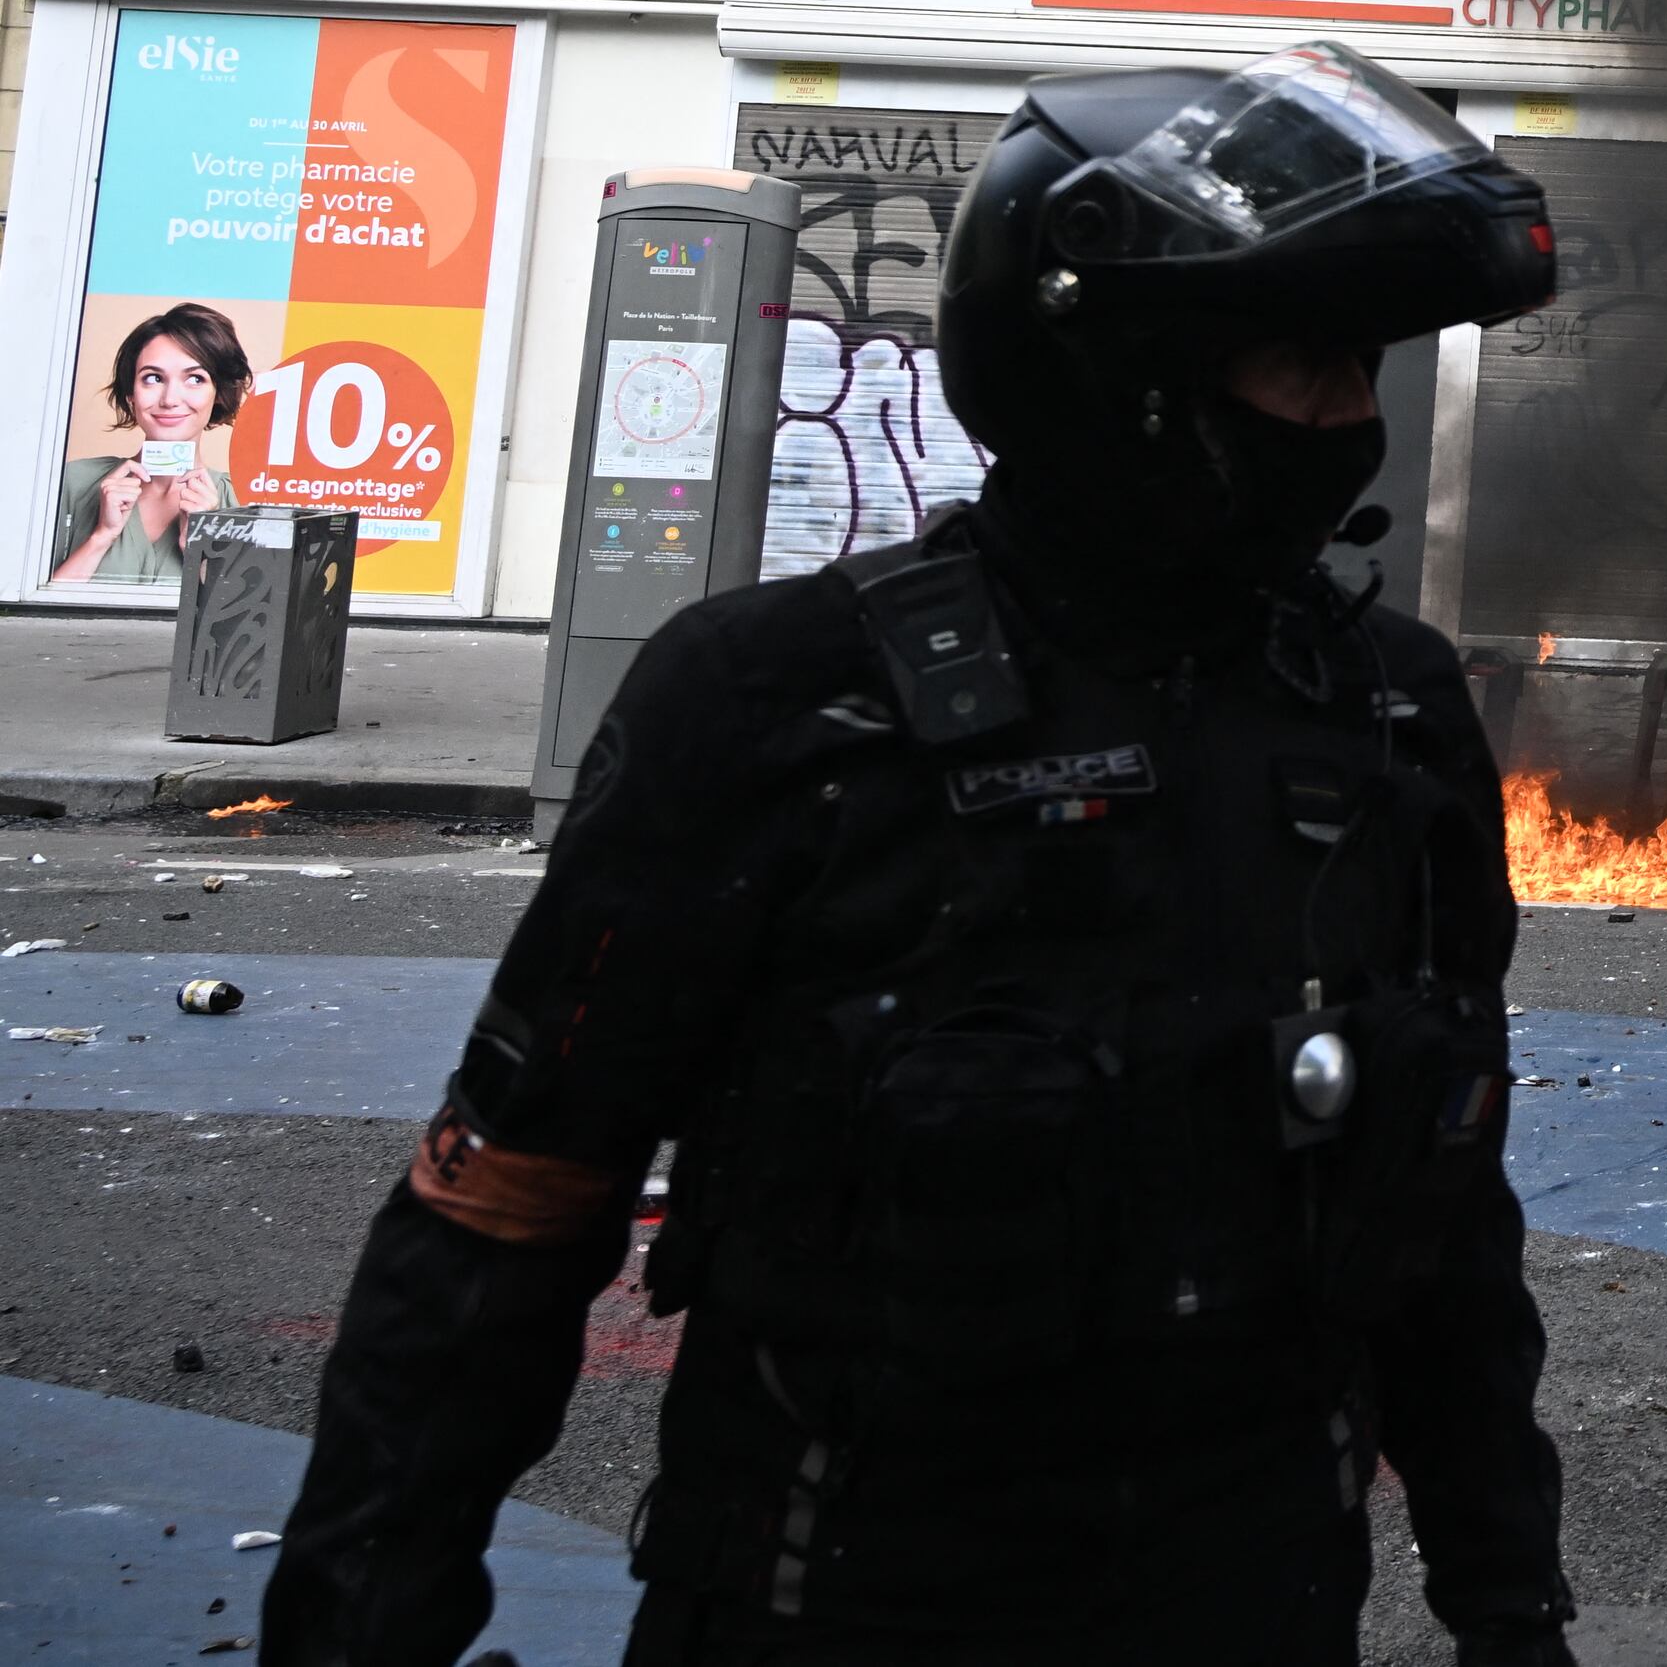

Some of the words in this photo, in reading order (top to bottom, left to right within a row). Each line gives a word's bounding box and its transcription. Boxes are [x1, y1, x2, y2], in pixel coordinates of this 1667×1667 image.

[249, 117, 267, 128] DU
[290, 119, 308, 130] AU
[312, 120, 327, 131] 30
[331, 120, 368, 133] AVRIL
[191, 151, 264, 179] Votre
[271, 155, 416, 184] pharmacie
[205, 185, 314, 216] protège
[322, 190, 394, 213] votre
[166, 215, 298, 246] pouvoir
[623, 310, 638, 319] Place
[638, 311, 647, 319] de
[653, 312, 675, 321] Nation
[657, 324, 674, 332] Paris
[253, 360, 442, 472] 10%
[250, 472, 280, 493] de
[350, 502, 422, 518] exclusive
[961, 747, 1144, 794] POLICE
